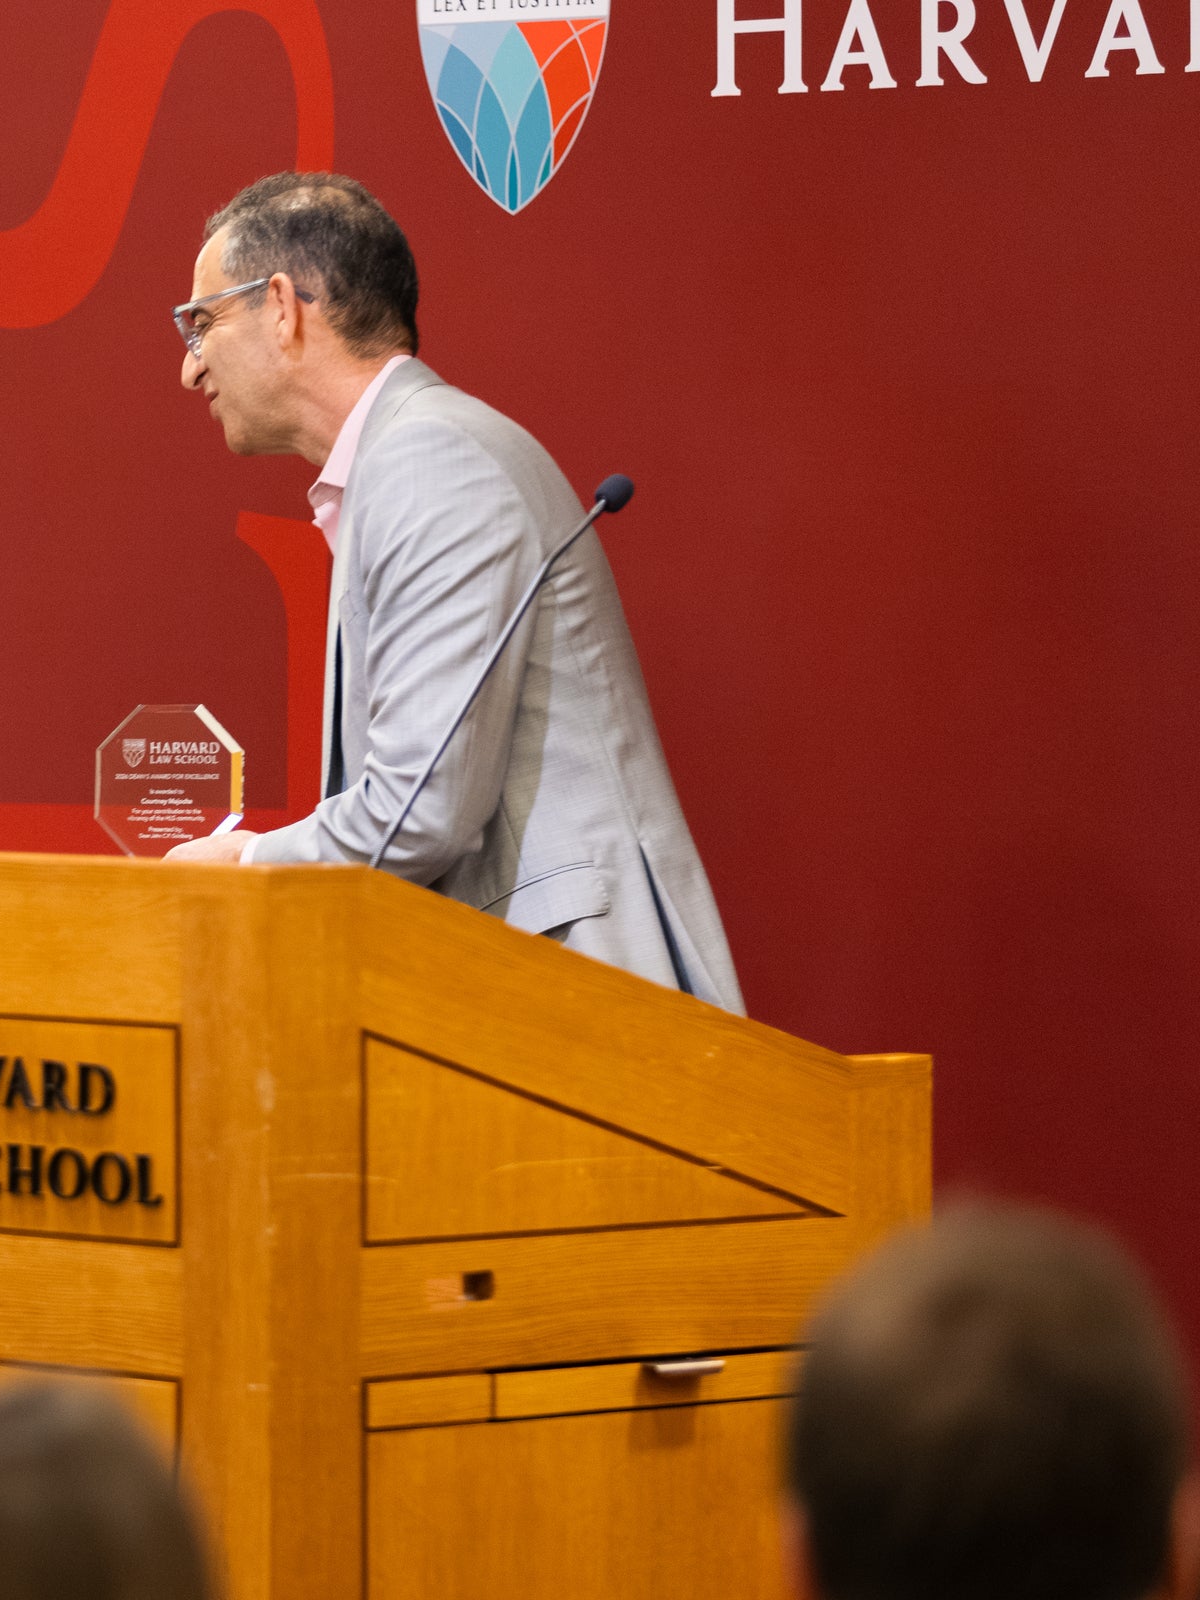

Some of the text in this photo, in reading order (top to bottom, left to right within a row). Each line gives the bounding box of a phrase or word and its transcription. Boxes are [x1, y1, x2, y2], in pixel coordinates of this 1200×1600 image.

[710, 0, 1200, 97] HARVA
[149, 741, 220, 754] HARVARD
[149, 755, 219, 764] LAW SCHOOL
[140, 797, 167, 807] Courtney
